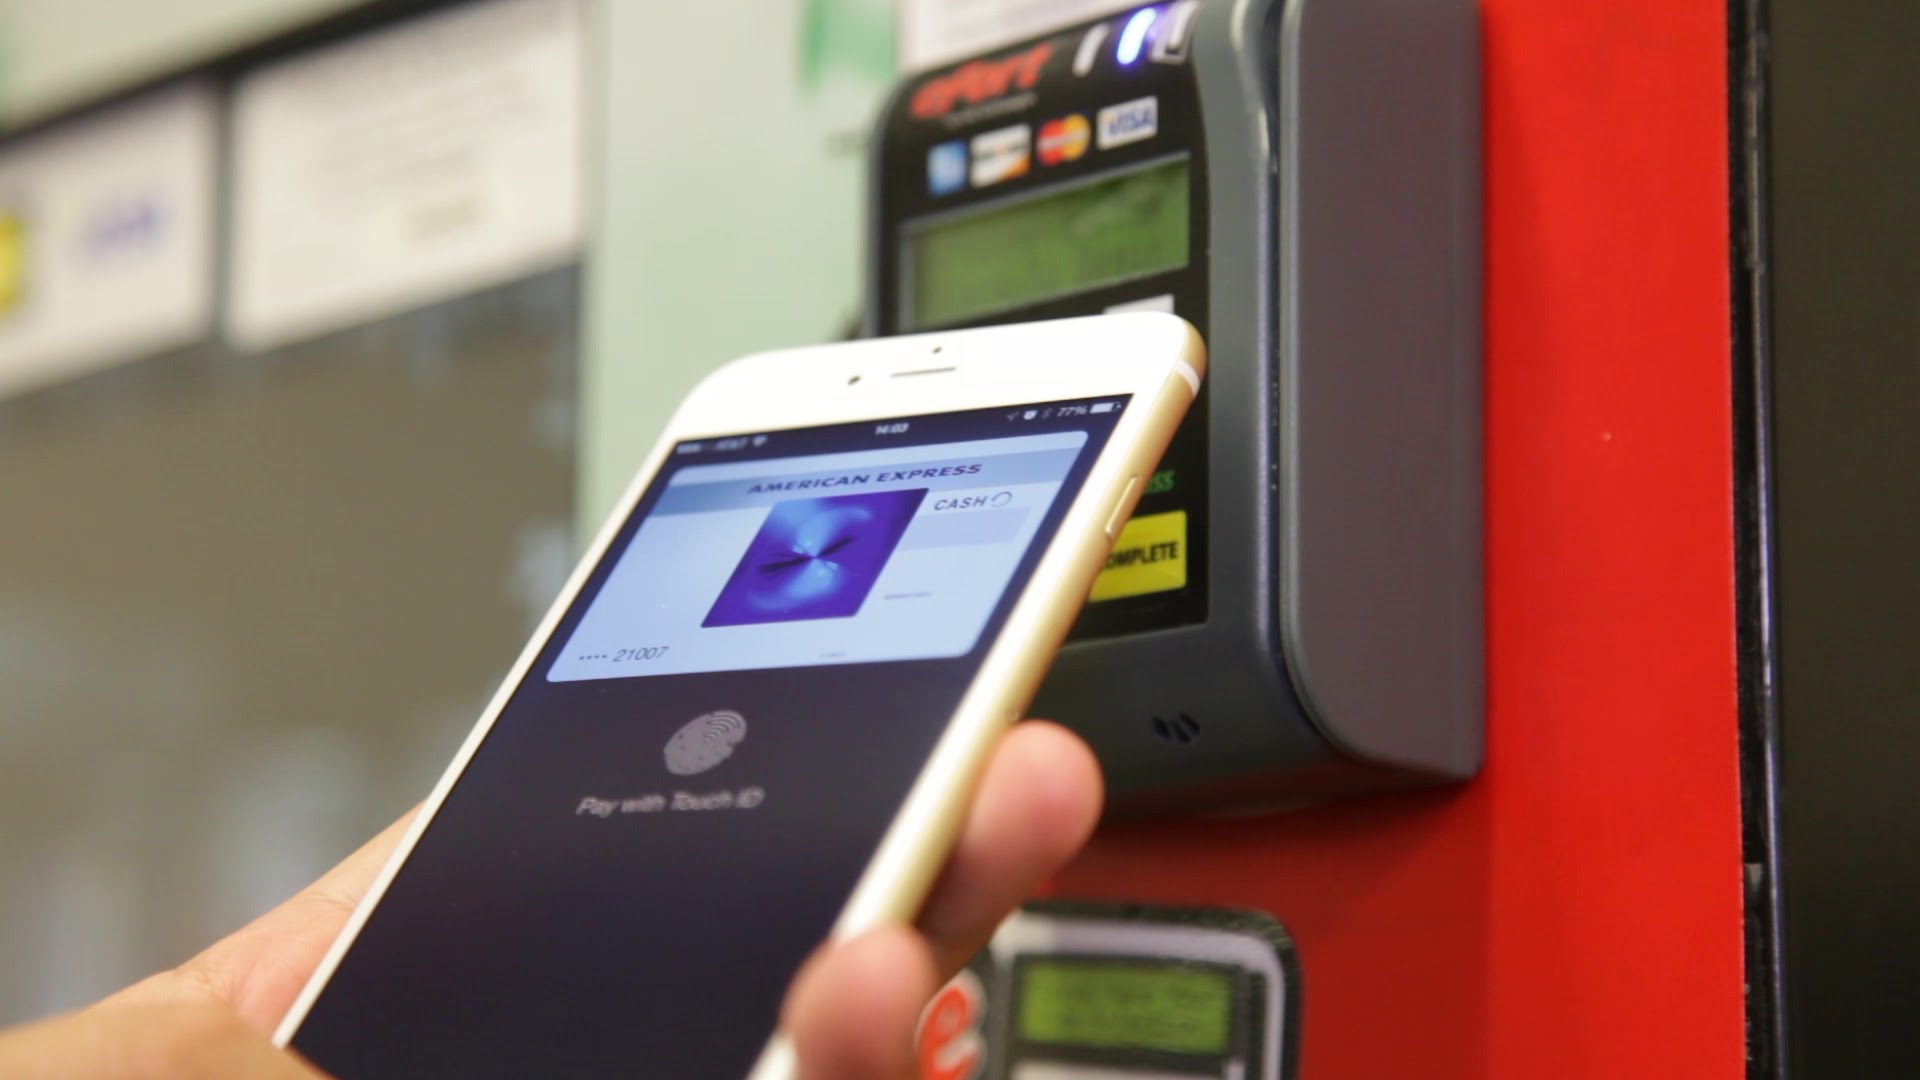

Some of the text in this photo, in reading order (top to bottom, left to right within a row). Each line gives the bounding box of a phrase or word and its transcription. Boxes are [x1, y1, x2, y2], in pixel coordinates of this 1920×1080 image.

[1056, 405, 1088, 418] 77%
[746, 463, 983, 495] AMERICAN EXPRESS
[933, 494, 988, 512] CASH
[1104, 541, 1178, 571] OMPLETE
[611, 645, 670, 663] 21007
[576, 795, 619, 819] Pay
[620, 793, 667, 813] with
[670, 789, 734, 812] Touch
